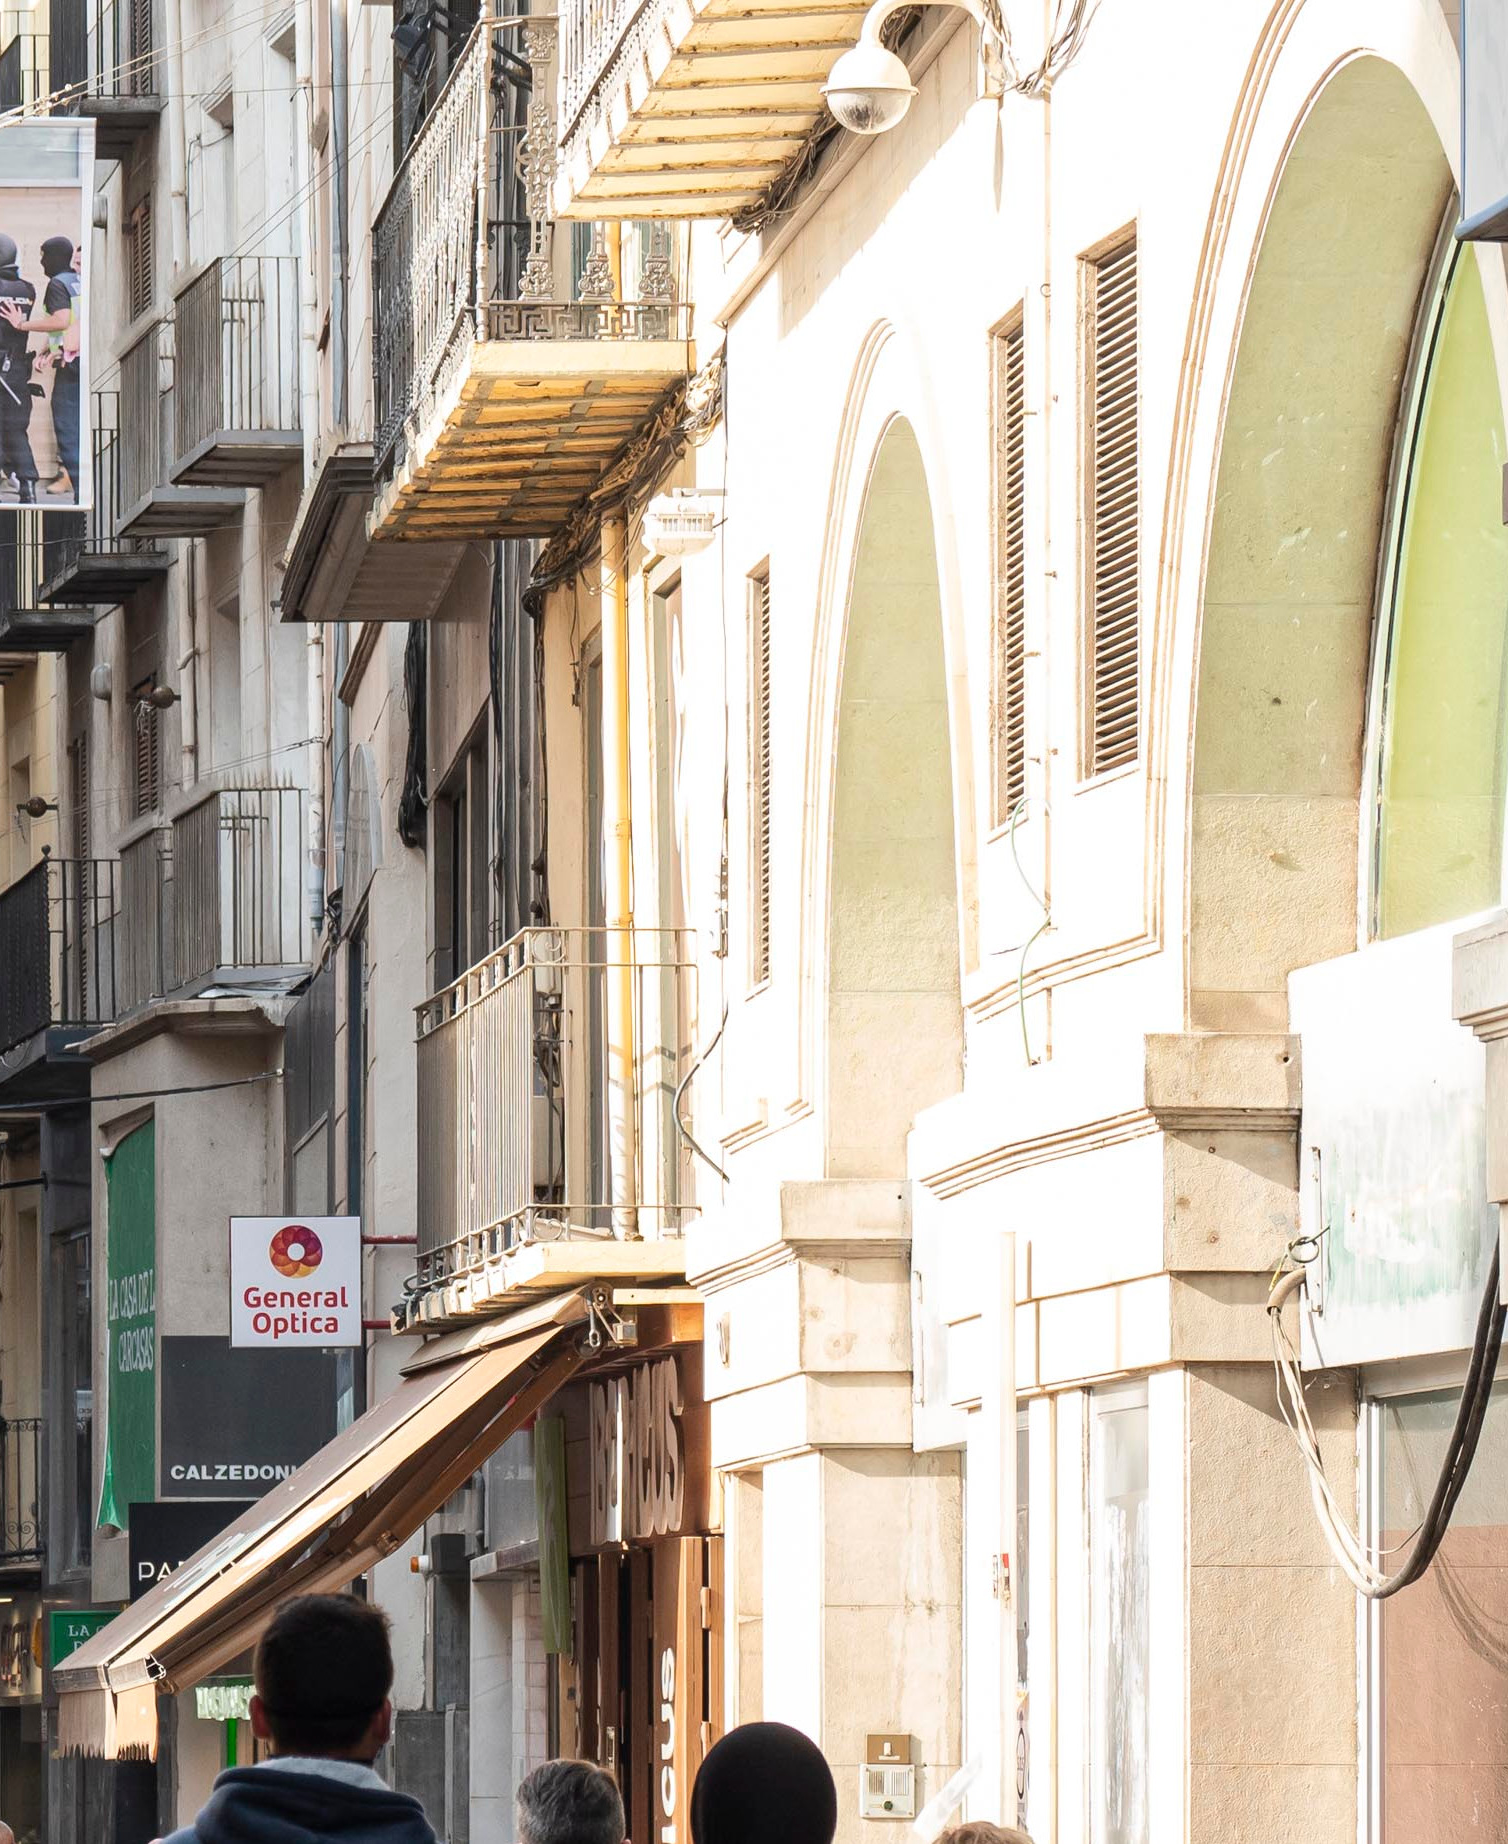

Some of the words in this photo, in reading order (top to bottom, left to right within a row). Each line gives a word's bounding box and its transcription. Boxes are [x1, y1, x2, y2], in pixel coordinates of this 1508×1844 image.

[109, 1279, 119, 1321] LA
[120, 1273, 138, 1319] CASA
[138, 1271, 149, 1316] DE
[243, 1286, 349, 1308] General
[252, 1311, 339, 1339] Optica
[118, 1326, 154, 1372] CARCASAS
